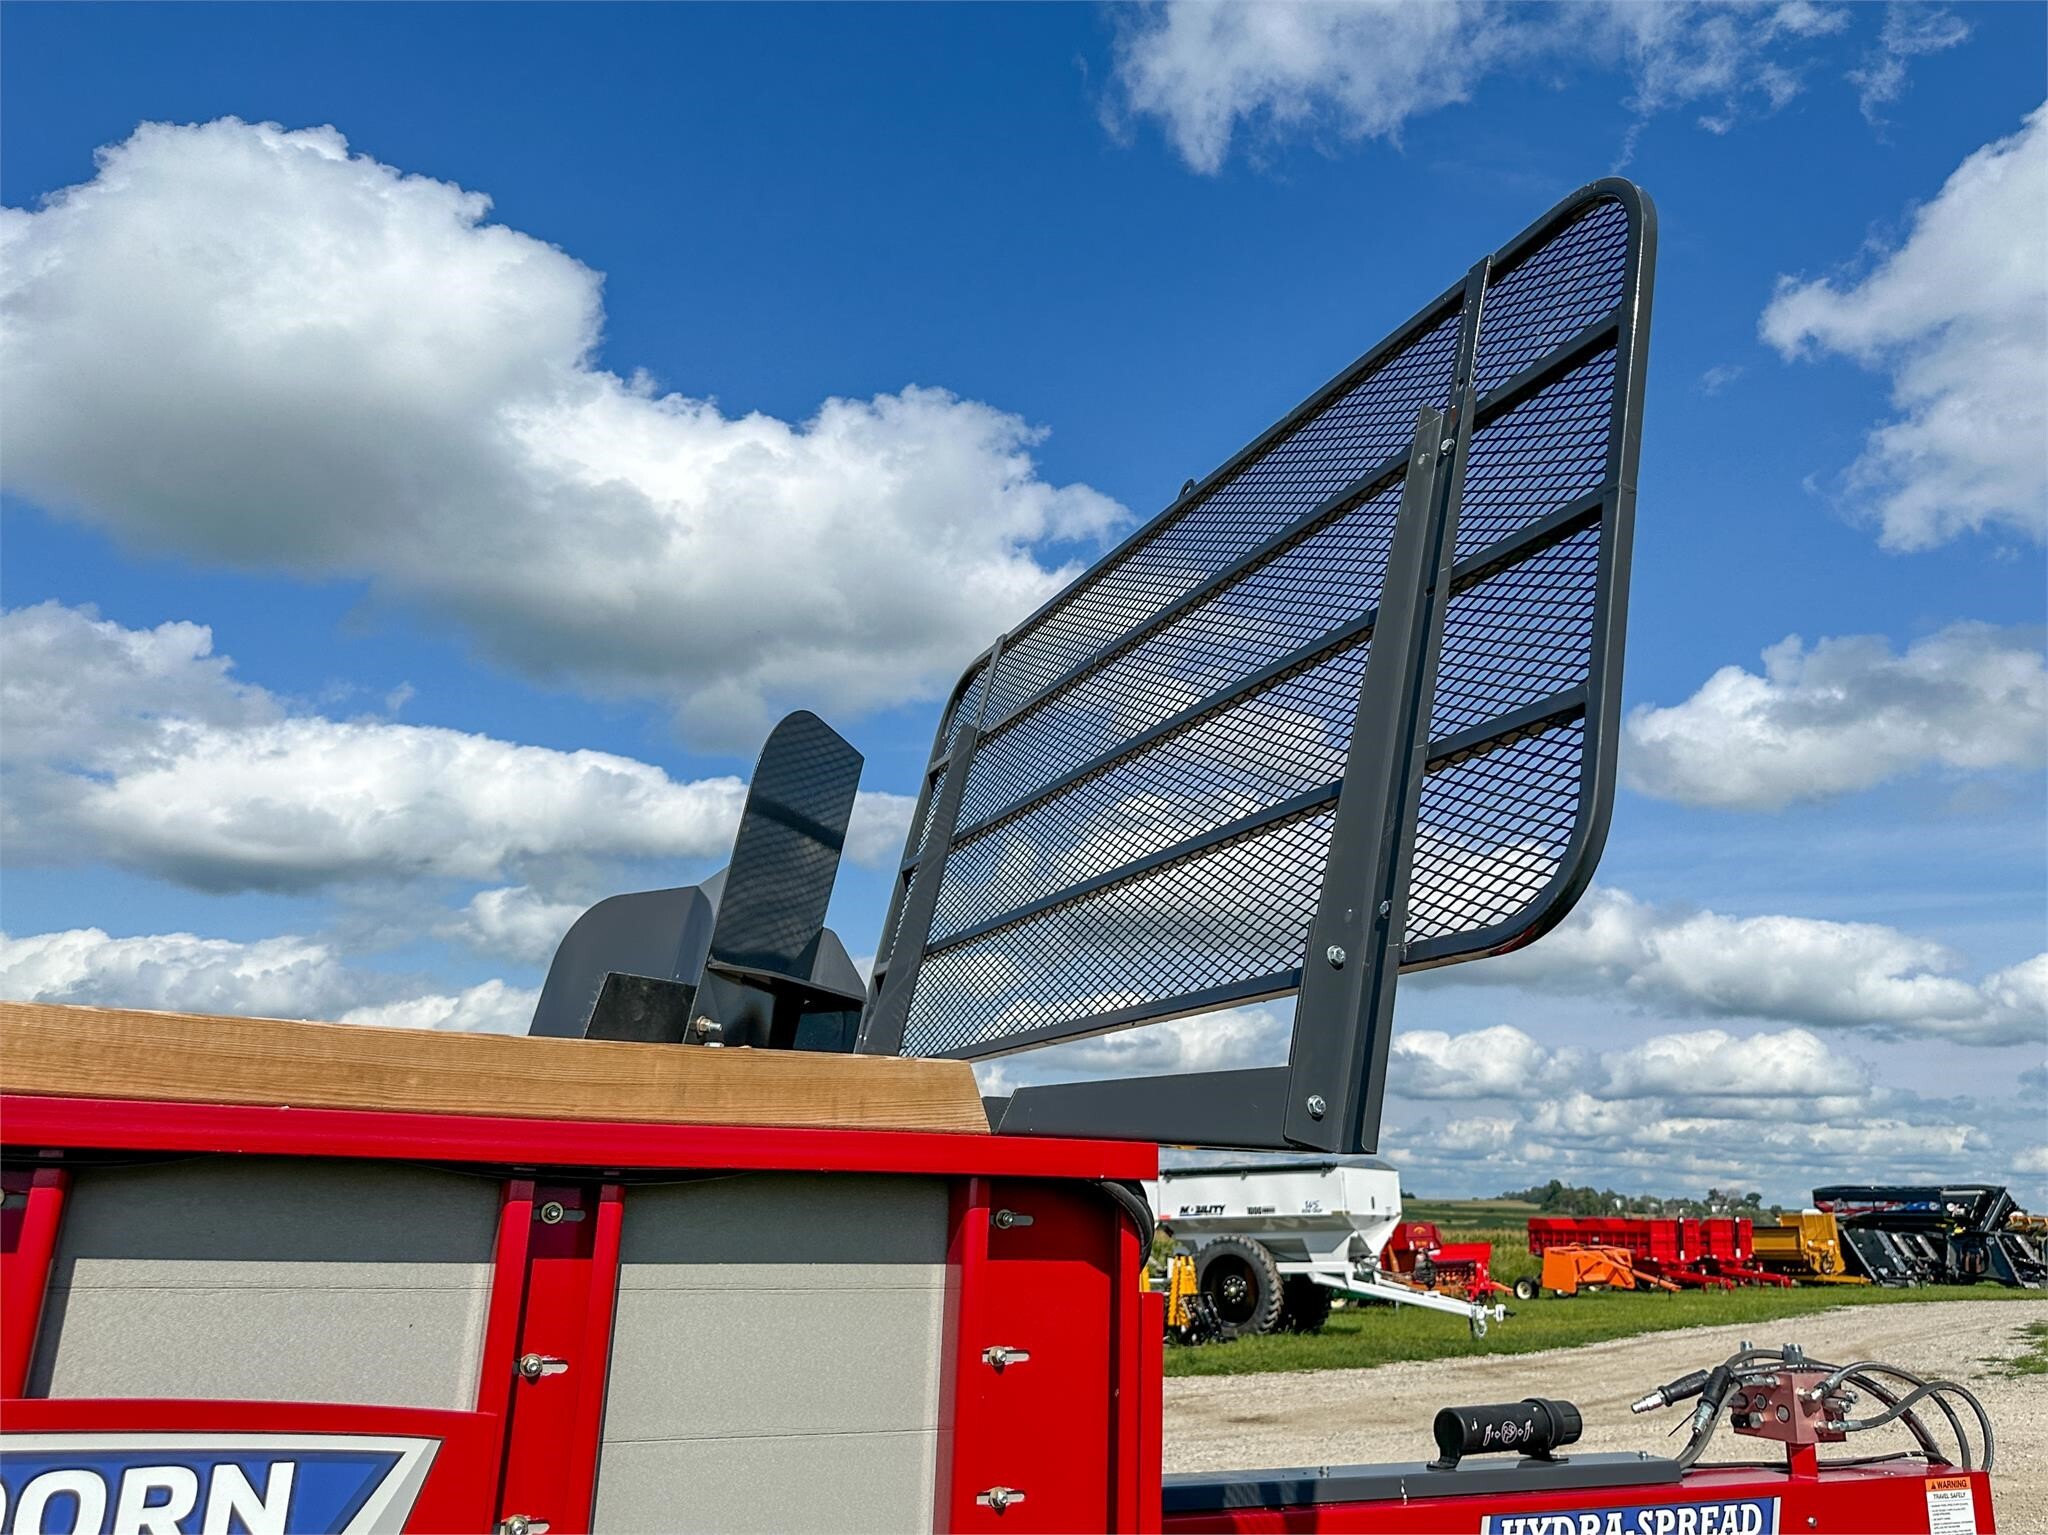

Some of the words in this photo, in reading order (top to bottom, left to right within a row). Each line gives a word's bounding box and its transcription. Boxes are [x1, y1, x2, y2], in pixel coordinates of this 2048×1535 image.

[0, 1461, 296, 1535] ORN
[1936, 1479, 1967, 1489] WARNING
[1501, 1503, 1763, 1535] HYDRA-SPREAD
